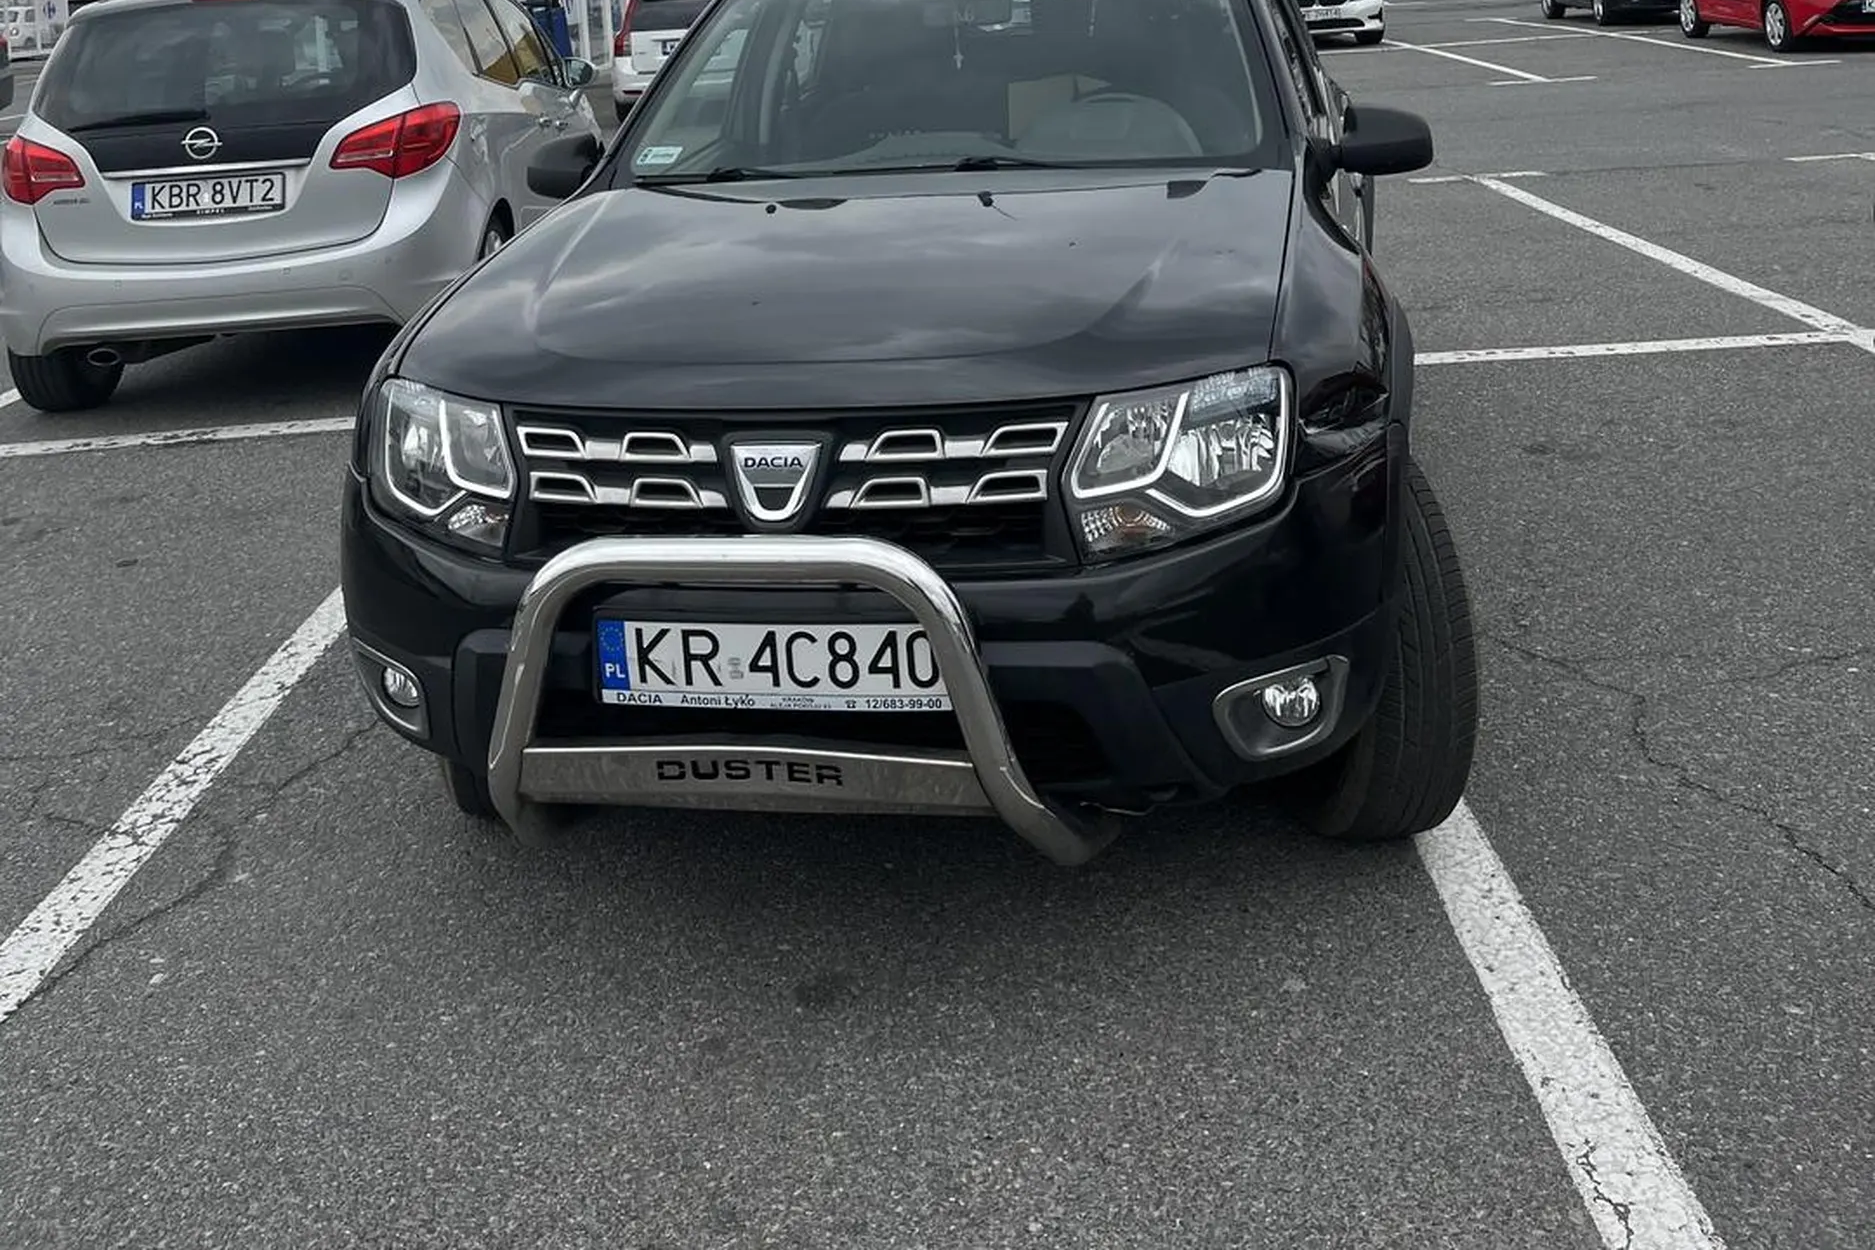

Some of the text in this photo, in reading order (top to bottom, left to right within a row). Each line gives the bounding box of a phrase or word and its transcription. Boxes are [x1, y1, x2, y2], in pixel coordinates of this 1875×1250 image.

[151, 178, 275, 210] KBR 8VT2
[744, 456, 803, 468] DACIA
[635, 627, 940, 689] KR 4C840
[604, 663, 626, 678] PL
[616, 692, 663, 704] DACIA
[680, 694, 721, 706] Antoni
[865, 699, 942, 709] 12/683-99-00
[656, 759, 844, 786] DUSTER
